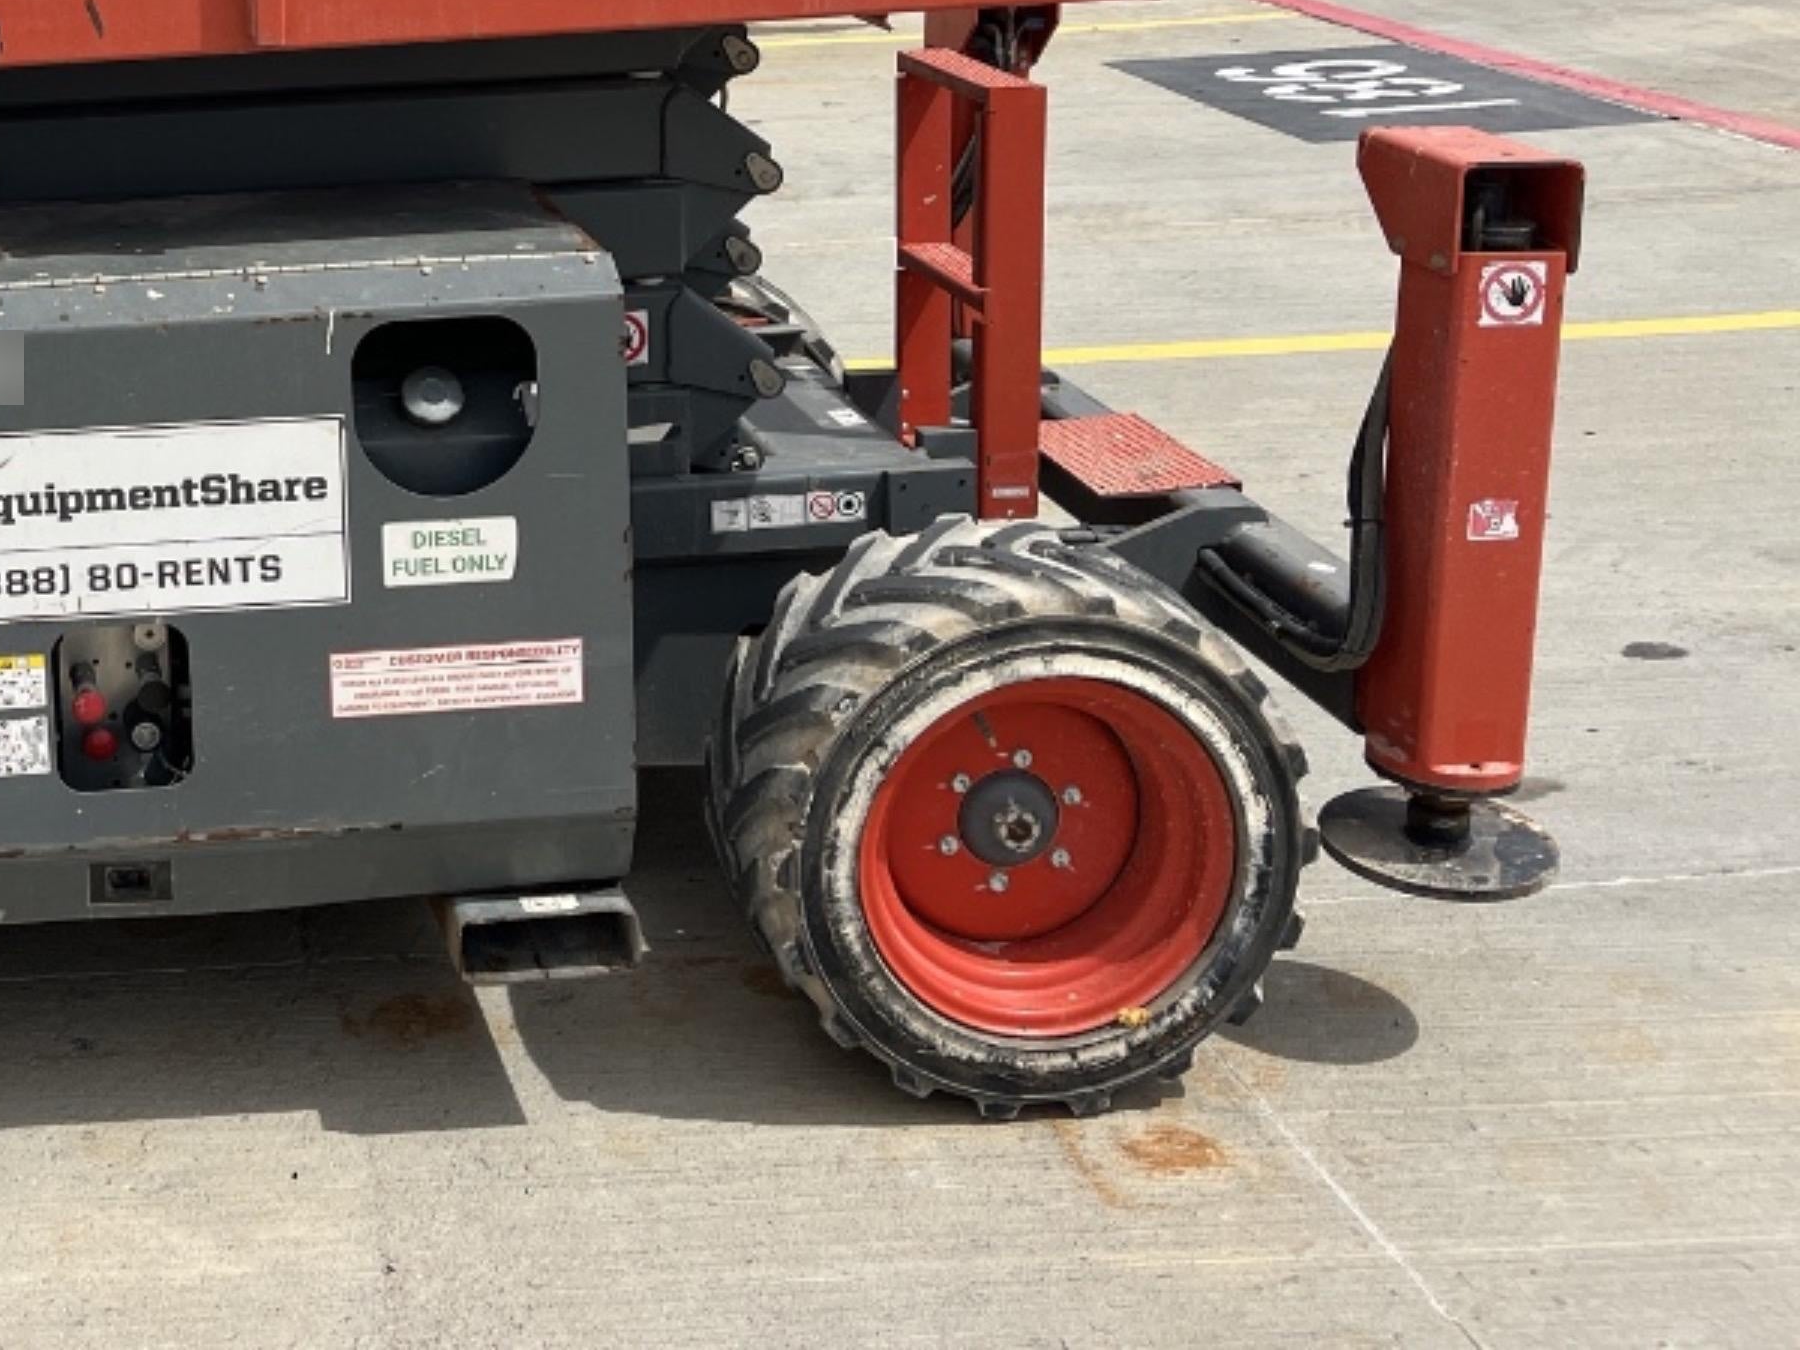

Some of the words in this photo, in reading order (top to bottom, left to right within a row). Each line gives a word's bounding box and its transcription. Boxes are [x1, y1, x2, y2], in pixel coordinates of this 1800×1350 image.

[412, 527, 488, 550] DIESEL
[87, 554, 283, 592] 80-RENTS
[392, 556, 448, 577] FUEL
[451, 553, 508, 574] ONLY
